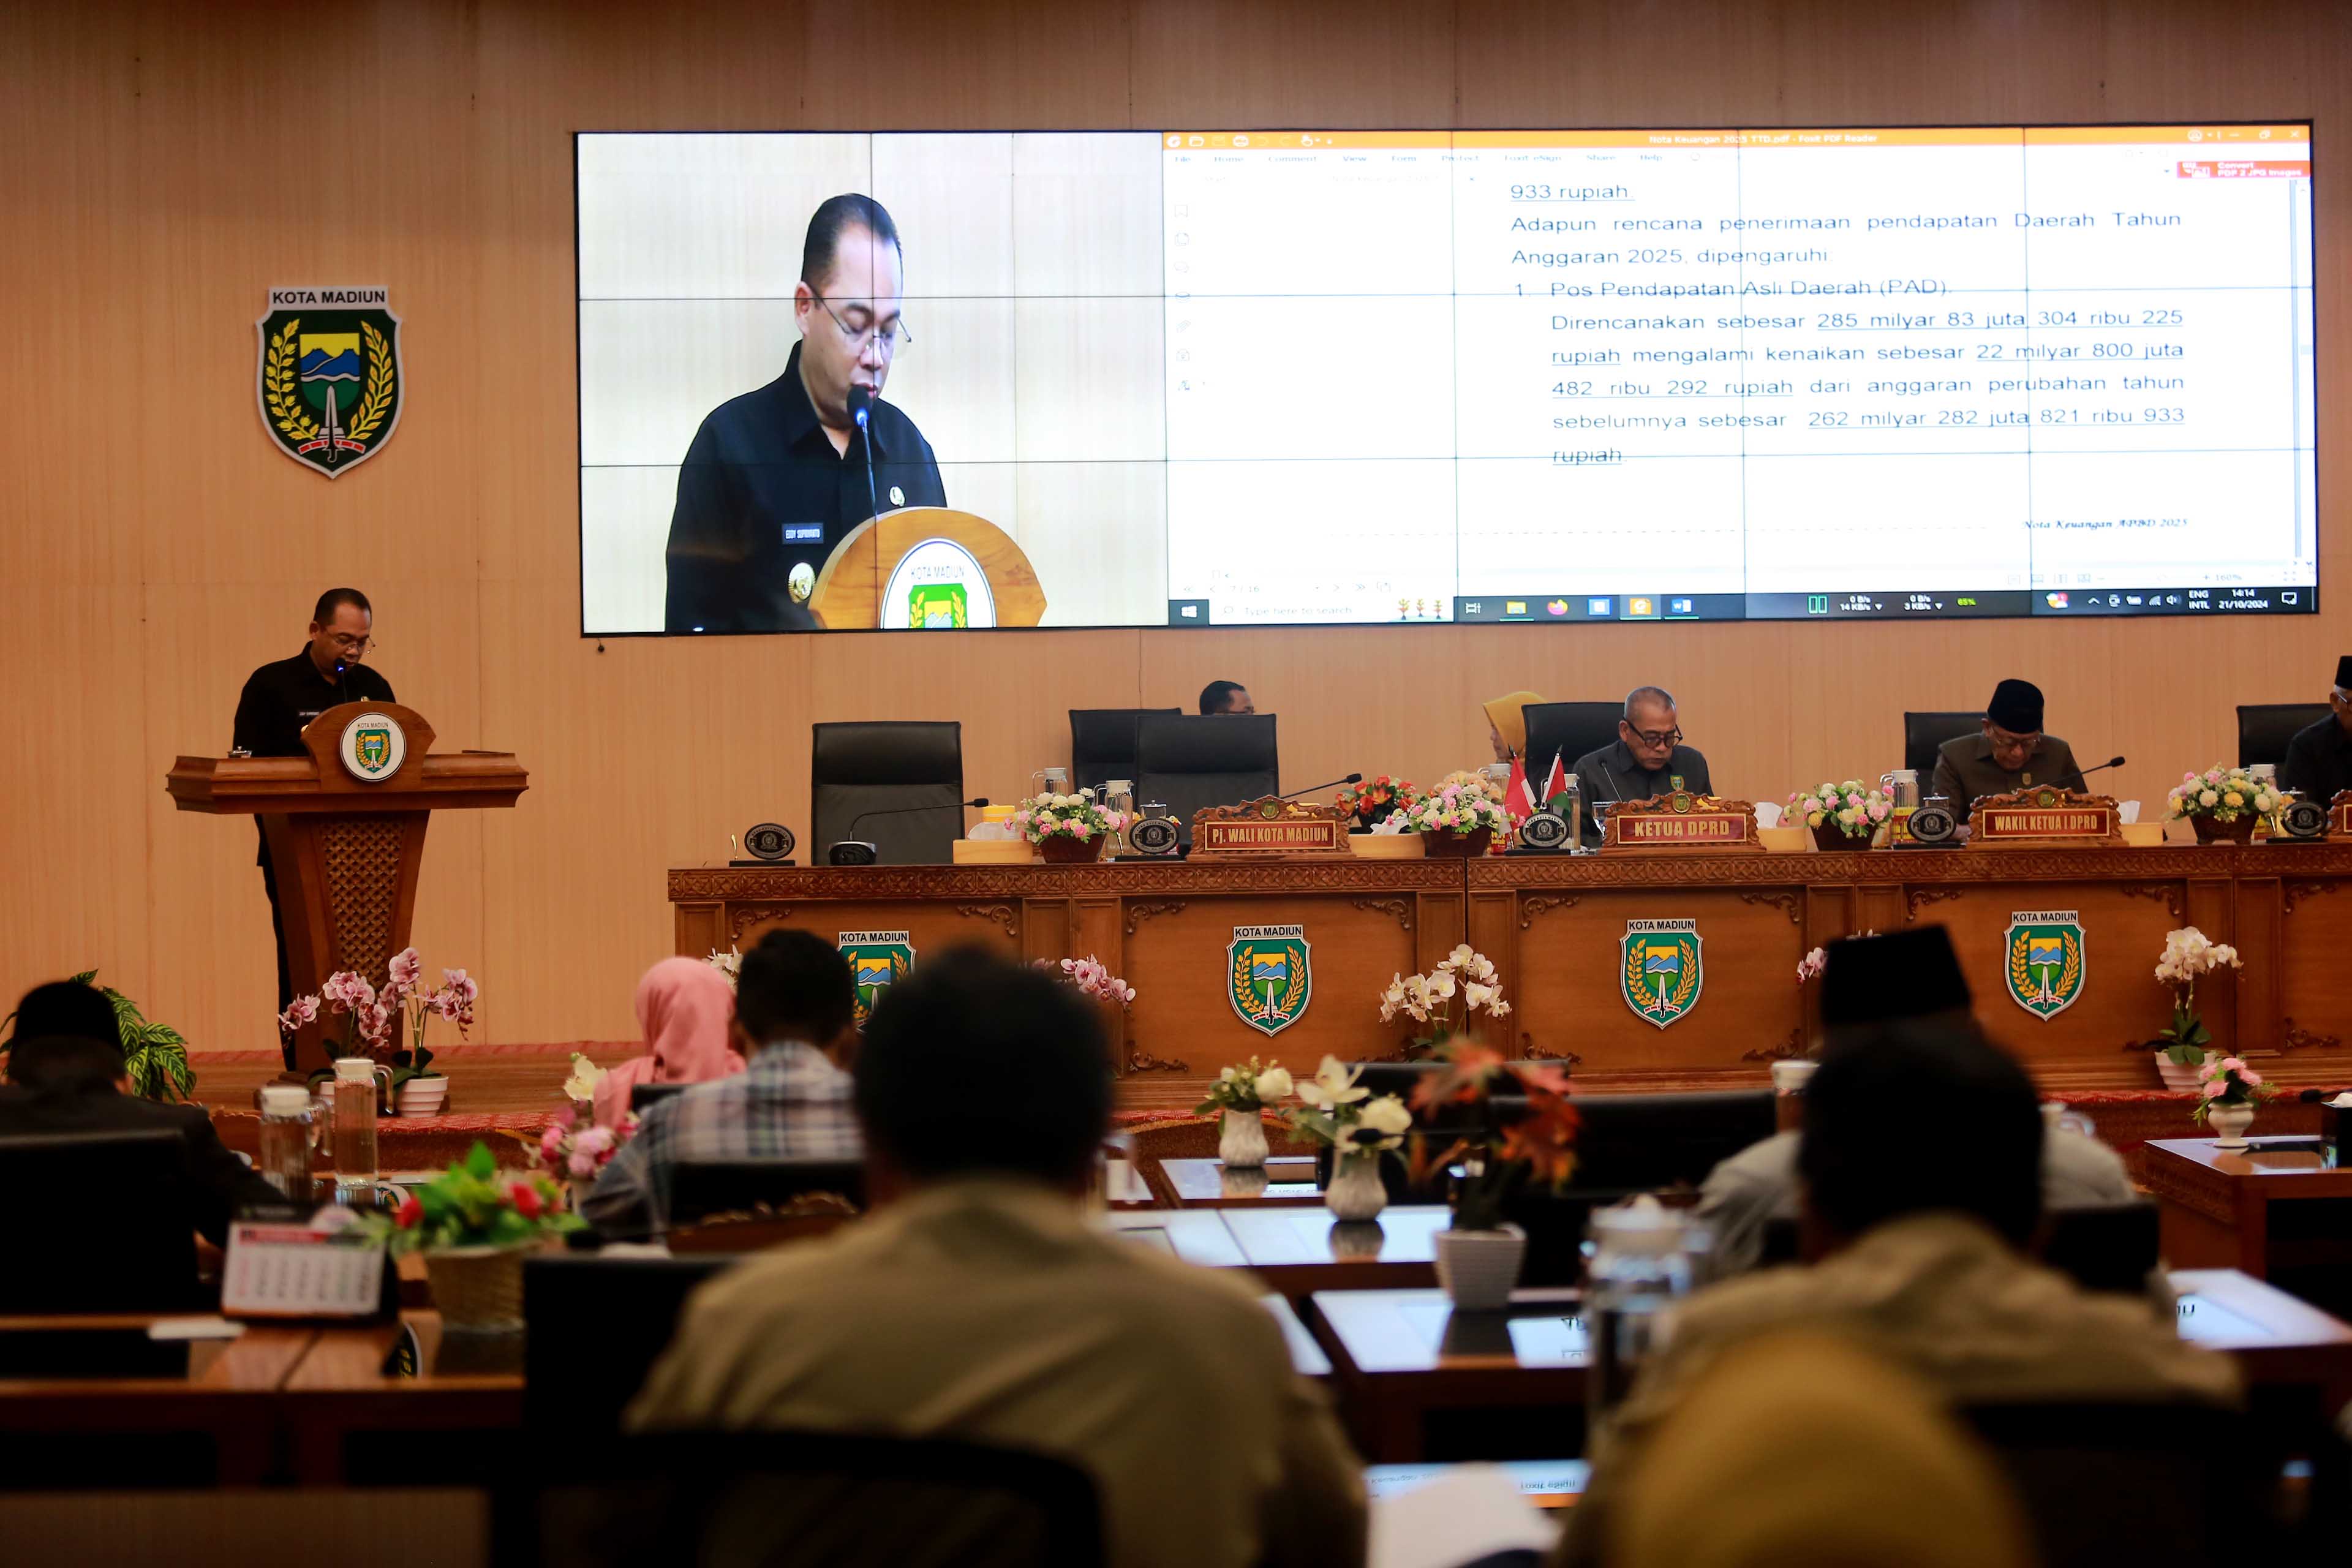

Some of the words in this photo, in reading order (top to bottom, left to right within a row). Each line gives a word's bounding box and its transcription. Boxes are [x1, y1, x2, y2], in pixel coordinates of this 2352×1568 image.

[1649, 135, 1672, 144] Nota
[1675, 135, 1720, 145] Keuangan
[1824, 134, 1842, 143] PDF
[1844, 134, 1877, 143] Reader
[2268, 168, 2302, 176] Images
[1510, 184, 1551, 199] 933
[1510, 217, 1597, 234] Adapun
[1613, 219, 1702, 232] rencana
[1720, 216, 1850, 232] penerimaan
[1868, 213, 1998, 232] pendapatan
[2014, 212, 2095, 228] Daerah
[2112, 211, 2182, 228] Tahun
[1512, 249, 1619, 268] Anggaran
[1551, 282, 1593, 298] Pos
[1601, 281, 1735, 299] Pendapatan
[1743, 281, 1783, 296] Asli
[1791, 279, 1871, 296] Daerah
[273, 292, 317, 304] KOTA
[322, 290, 385, 303] MADIUN
[1552, 314, 1705, 330] Direncanakan
[1717, 314, 1806, 329] sebesar
[1818, 312, 1858, 328] 285
[1870, 311, 1936, 330] milyar
[1948, 312, 1975, 327] 83
[1986, 311, 2026, 329] juta
[2038, 311, 2078, 325] 304
[2090, 310, 2131, 325] ribu
[2142, 309, 2183, 325] 225
[1552, 348, 1621, 365] rupiah
[1633, 347, 1755, 366] mengalami
[1766, 345, 1864, 361] kenaikan
[1877, 344, 1965, 360] sebesar
[1977, 344, 2003, 359] 22
[2016, 343, 2082, 361] milyar
[2092, 342, 2134, 358] 800
[2144, 342, 2184, 360] juta
[1552, 380, 1594, 396] 482
[1610, 380, 1651, 396] ribu
[1667, 380, 1708, 395] 292
[1725, 379, 1794, 397] rupiah
[1810, 379, 1851, 394] dari
[1868, 379, 1972, 396] anggaran
[1989, 376, 2107, 395] perubahan
[2122, 375, 2185, 391] tahun
[1553, 413, 1687, 431] sebelumnya
[1698, 412, 1787, 428] sebesar
[1808, 412, 1849, 427] 262
[1861, 410, 1926, 429] milyar
[1938, 410, 1978, 425] 282
[1989, 409, 2029, 428] juta
[2040, 409, 2079, 424] 821
[2093, 408, 2133, 423] ribu
[2144, 408, 2185, 423] 933
[2022, 519, 2051, 529] Nota
[2056, 520, 2113, 530] Keuangan
[2160, 518, 2188, 527] 2025
[911, 566, 932, 579] KOTA
[934, 565, 965, 578] MADIUN
[1917, 595, 1931, 603] B/s
[2188, 590, 2209, 598] ENG
[2232, 589, 2255, 597] 14:14
[1852, 603, 1871, 611] KB/s
[2188, 600, 2210, 609] INTL
[2218, 600, 2269, 609] 21/10/2024
[1245, 607, 1270, 616] Type
[1634, 821, 1684, 837] KETUA
[1687, 820, 1730, 835] DPRD
[1994, 815, 2028, 831] WAKIL
[2030, 815, 2062, 831] KETUA
[2064, 815, 2068, 830] I
[2070, 815, 2098, 830] DPRD
[1212, 829, 1226, 843] Pj.
[1228, 828, 1254, 843] WALI
[1257, 827, 1284, 842] KOTA
[1286, 827, 1328, 842] MADIUN
[2013, 913, 2038, 921] KOTA
[2041, 913, 2077, 921] MADIUN
[1235, 927, 1262, 937] KOTA
[1264, 926, 1302, 936] MADIUN
[1629, 921, 1654, 930] KOTA
[1657, 921, 1694, 929] MADIUN
[840, 933, 867, 942] KOTA
[869, 932, 907, 941] MADIUN
